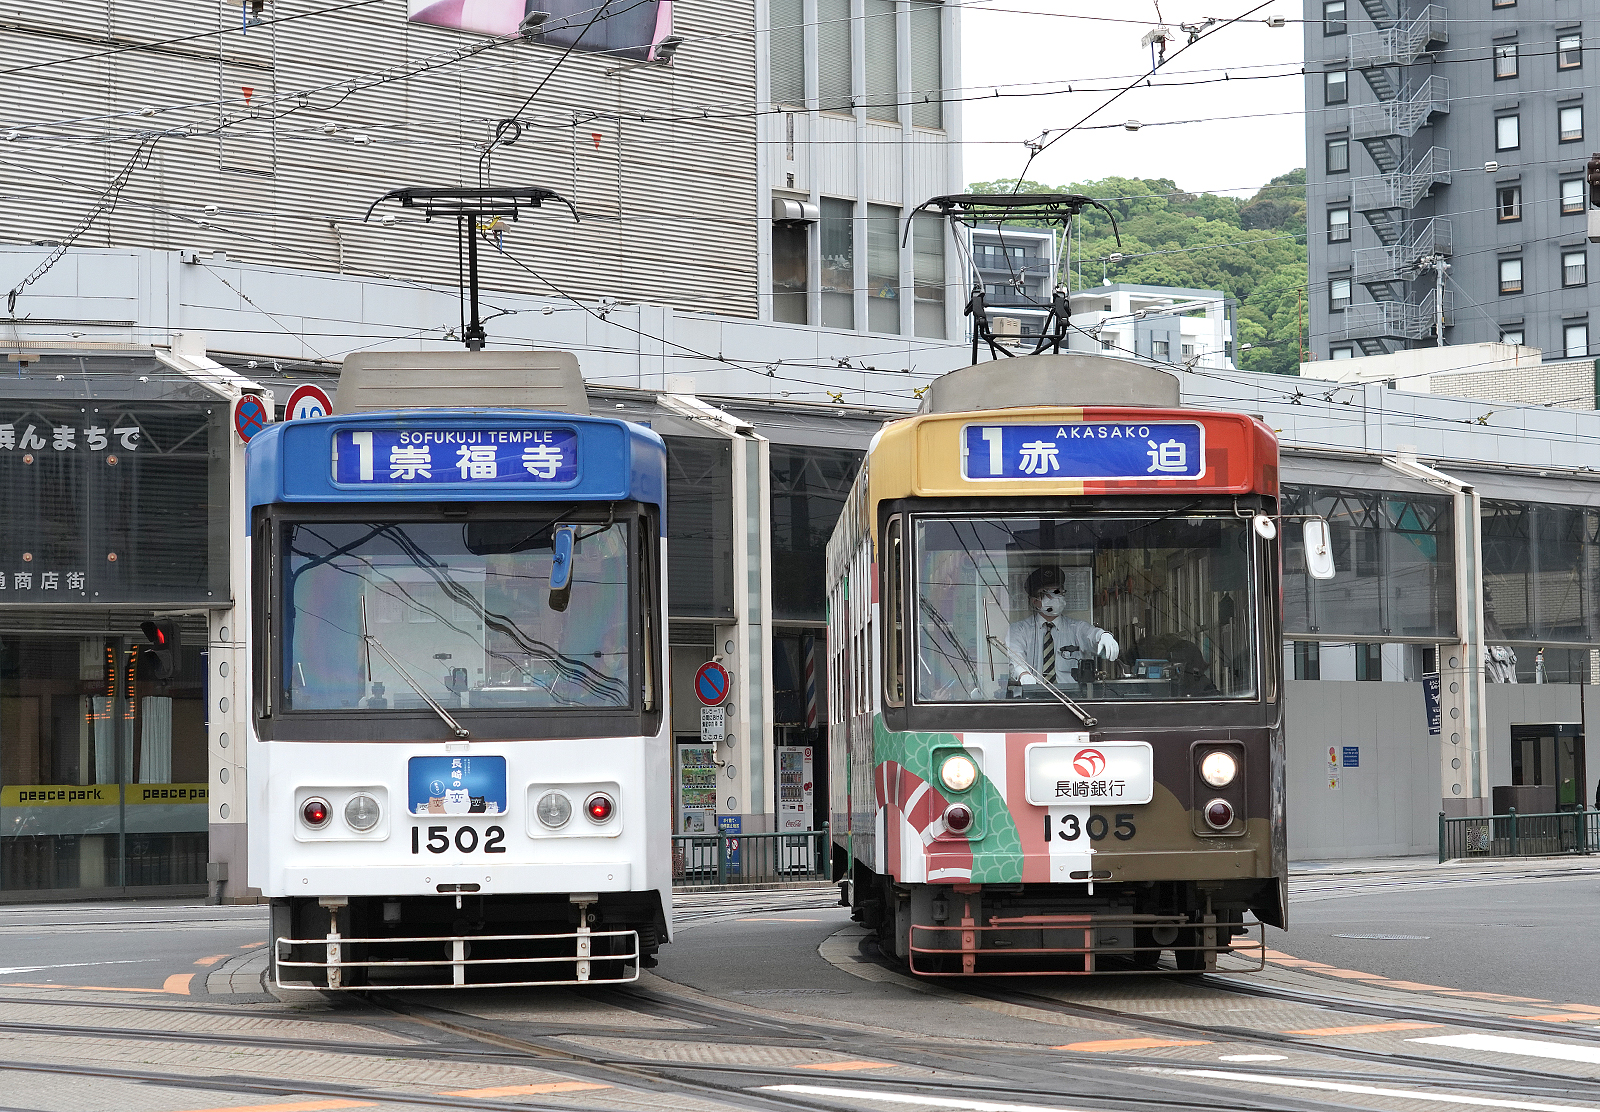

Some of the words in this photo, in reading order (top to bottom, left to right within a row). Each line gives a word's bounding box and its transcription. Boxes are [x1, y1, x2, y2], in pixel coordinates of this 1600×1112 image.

[400, 431, 483, 444] SOFUKUJI
[491, 431, 553, 443] TEMPLE
[1056, 426, 1150, 439] AKASAKO
[352, 431, 374, 481] 1
[389, 444, 564, 480] 崇福寺
[982, 427, 1003, 475] 1
[1018, 438, 1188, 475] 赤迫
[19, 790, 66, 802] peace
[142, 789, 187, 801] peace
[189, 788, 209, 800] pa
[1054, 780, 1126, 798] 長崎銀行
[411, 825, 507, 855] 1502
[1044, 813, 1136, 842] 1305
